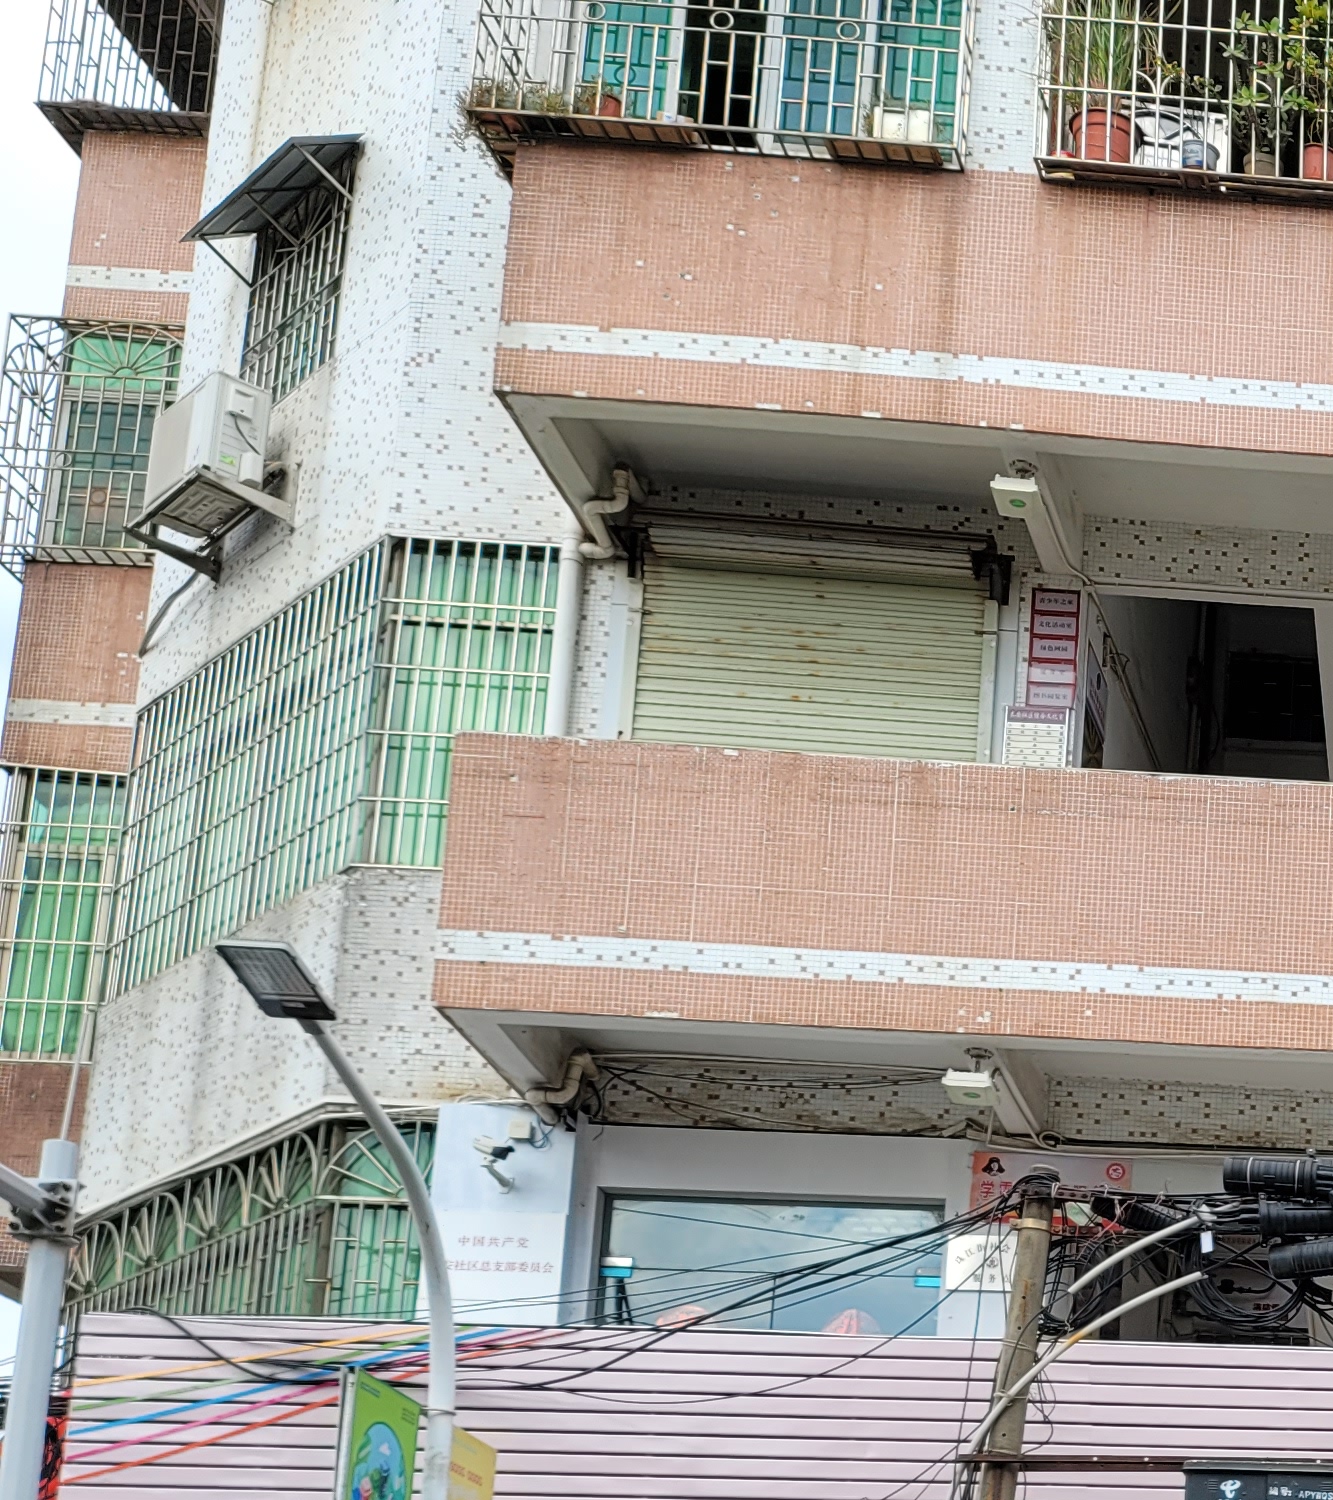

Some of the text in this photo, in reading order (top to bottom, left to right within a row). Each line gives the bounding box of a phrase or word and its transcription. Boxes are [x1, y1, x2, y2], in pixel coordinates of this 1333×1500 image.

[458, 1236, 529, 1249] 中国共产党
